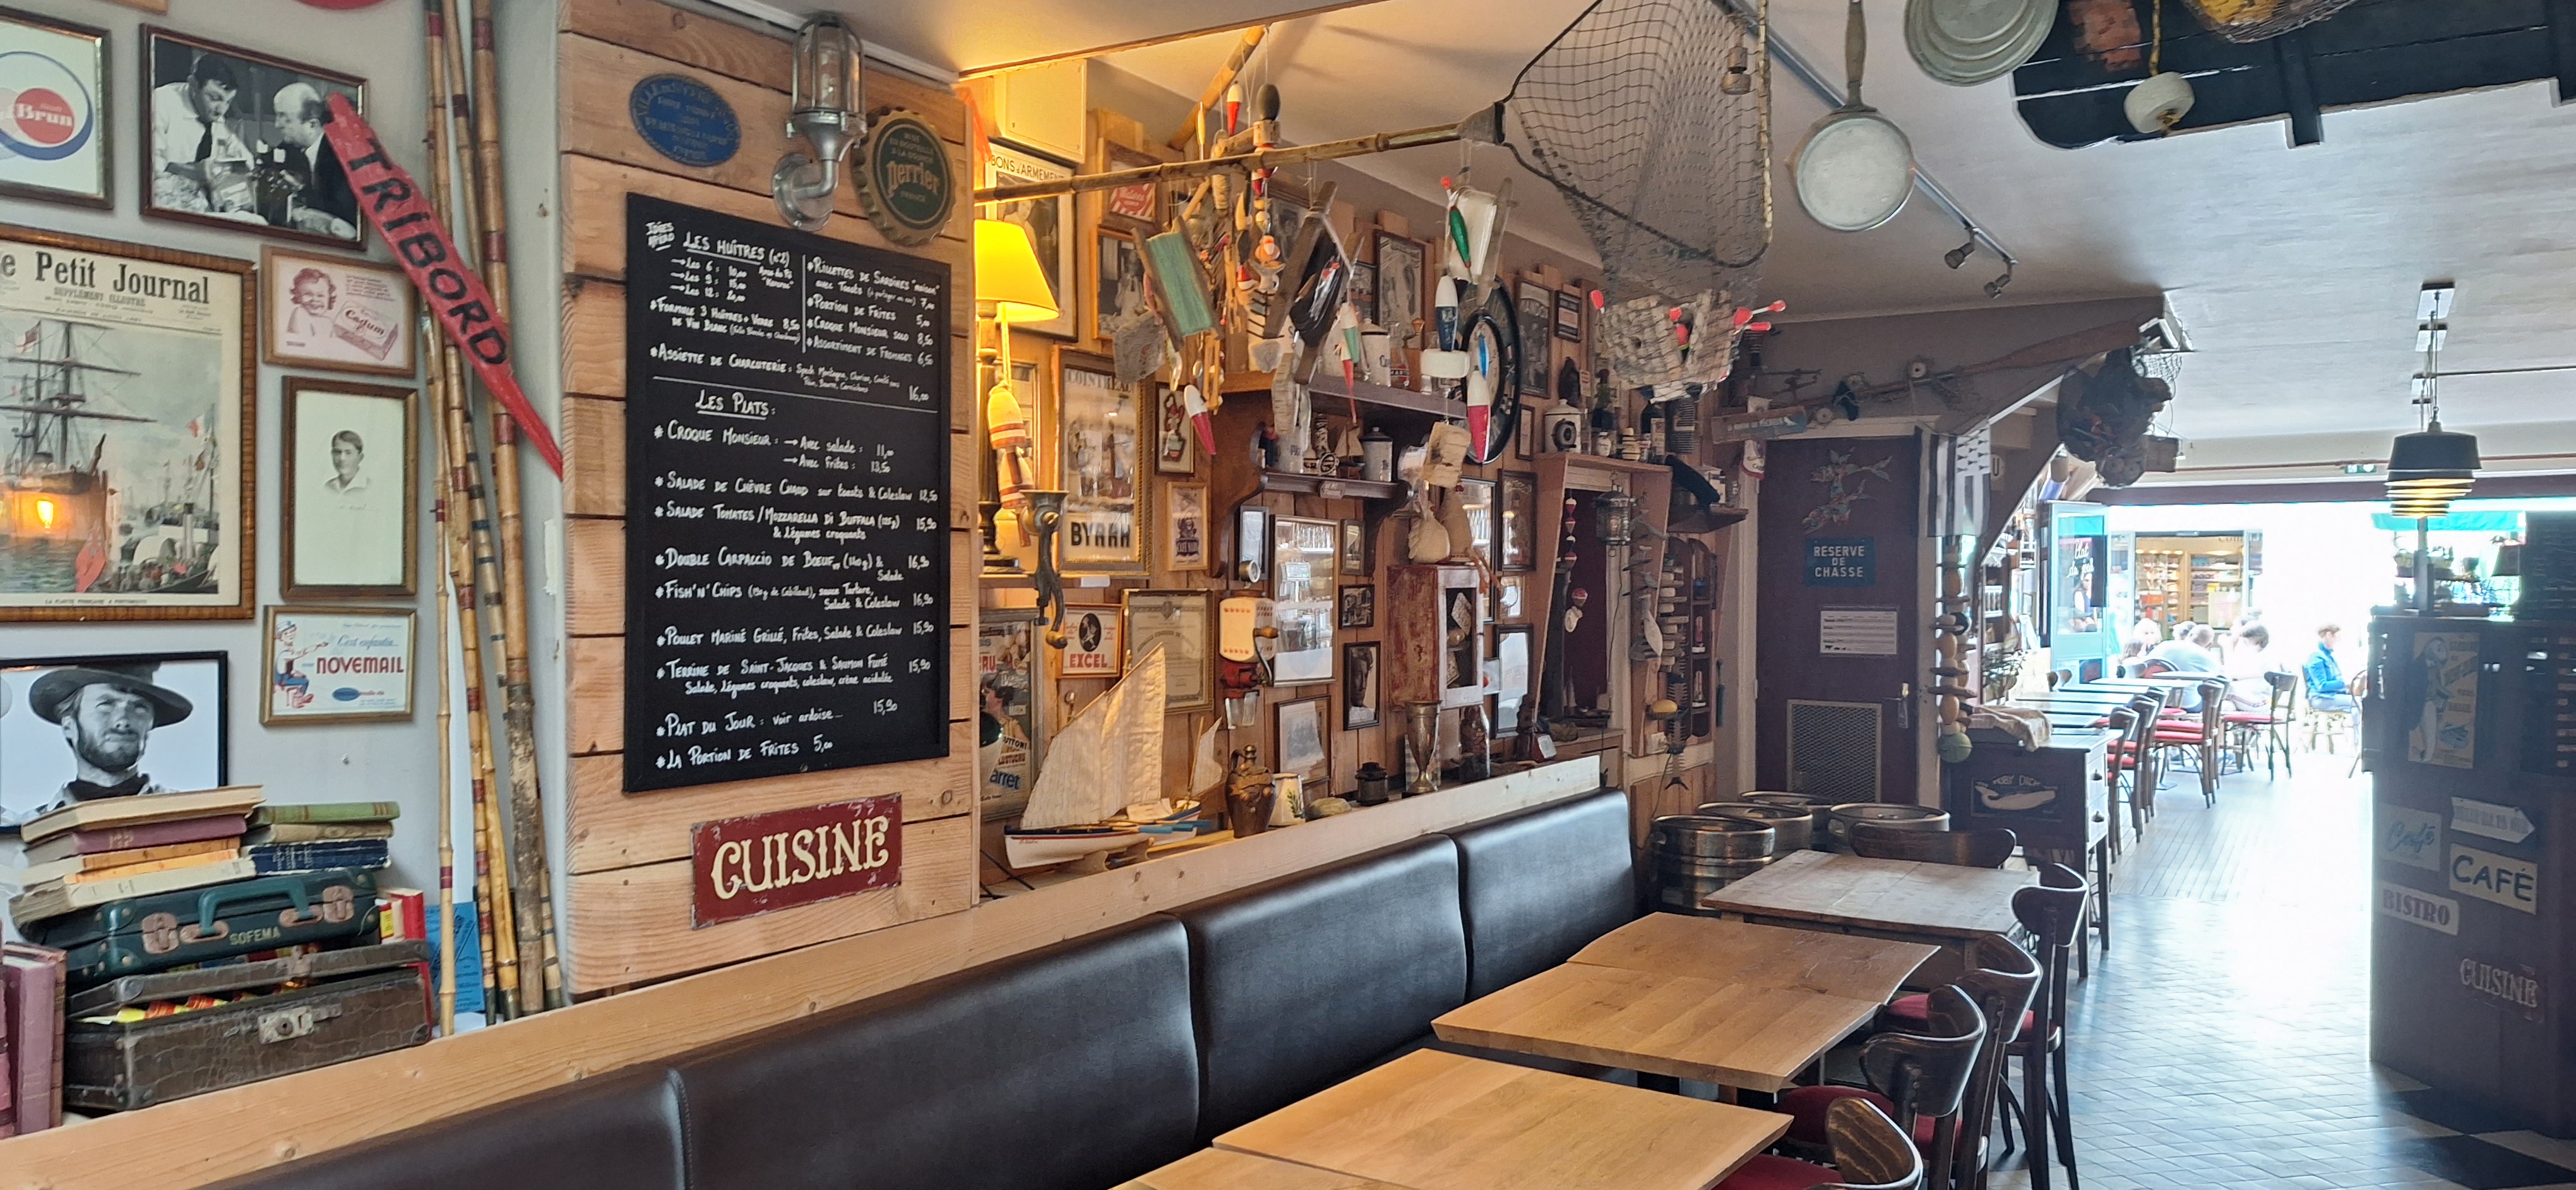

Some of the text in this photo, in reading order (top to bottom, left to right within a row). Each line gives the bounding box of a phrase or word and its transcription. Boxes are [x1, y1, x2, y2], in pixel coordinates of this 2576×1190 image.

[15, 103, 74, 127] Brun
[991, 155, 1015, 172] BONS
[349, 137, 508, 366] TRIBORD
[683, 231, 711, 251] LES
[717, 239, 765, 260] HUÎTRES
[0, 253, 16, 278] e
[35, 251, 96, 289] Petit
[113, 263, 210, 304] Journal
[700, 304, 708, 317] 3
[657, 342, 705, 364] ASSIETTE
[710, 355, 723, 366] DE
[695, 388, 725, 411] LES
[667, 419, 714, 443] CROQUE
[799, 435, 821, 450] Avec
[798, 453, 820, 469] Avec
[666, 470, 707, 491] SALADE
[713, 481, 728, 493] DE
[665, 499, 706, 519] SALADE
[664, 546, 711, 570] DOUBLE
[717, 546, 773, 567] CARPACCIO
[781, 555, 796, 567] DE
[1831, 556, 1846, 566] DE
[1814, 567, 1864, 578] CHASSE
[664, 625, 705, 646] POULET
[710, 627, 747, 646] MARINÉ
[823, 625, 853, 640] Salade
[866, 622, 903, 638] Coleslaw
[316, 656, 405, 675] NOVEMAIL
[665, 658, 710, 679] TERRINE
[716, 663, 731, 676] DE
[1070, 653, 1108, 668] EXCEL
[665, 712, 697, 737] PLAT
[701, 721, 717, 735] DU
[666, 748, 683, 769] LA
[687, 745, 732, 766] PORTION
[737, 747, 753, 762] DE
[759, 739, 800, 757] FRITES
[2385, 821, 2436, 853] Café
[710, 815, 891, 899] CUISINE
[2452, 854, 2534, 903] CAFÉ
[2383, 889, 2450, 925] BISTRO
[229, 925, 281, 946] SOFEMA
[2460, 958, 2538, 1008] CUISINE
